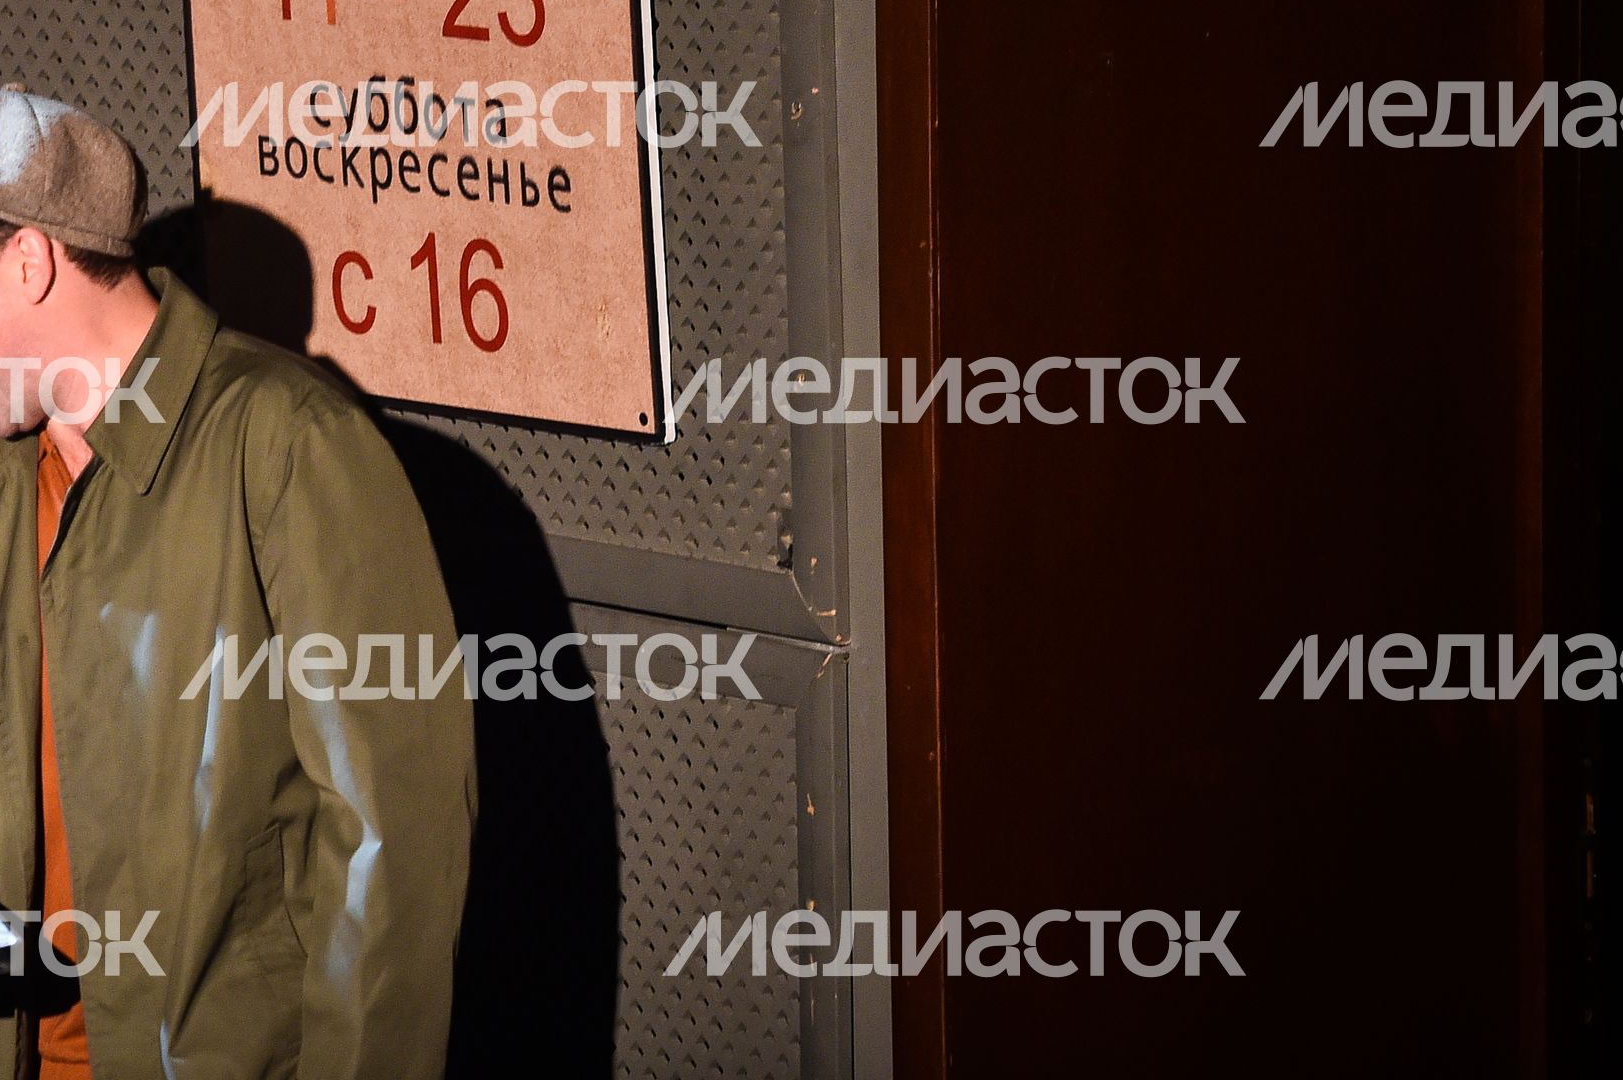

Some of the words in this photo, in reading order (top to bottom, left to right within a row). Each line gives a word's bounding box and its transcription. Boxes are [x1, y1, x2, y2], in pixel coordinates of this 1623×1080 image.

[309, 75, 508, 144] суббота
[258, 135, 572, 213] воскресенье
[410, 232, 509, 352] 16
